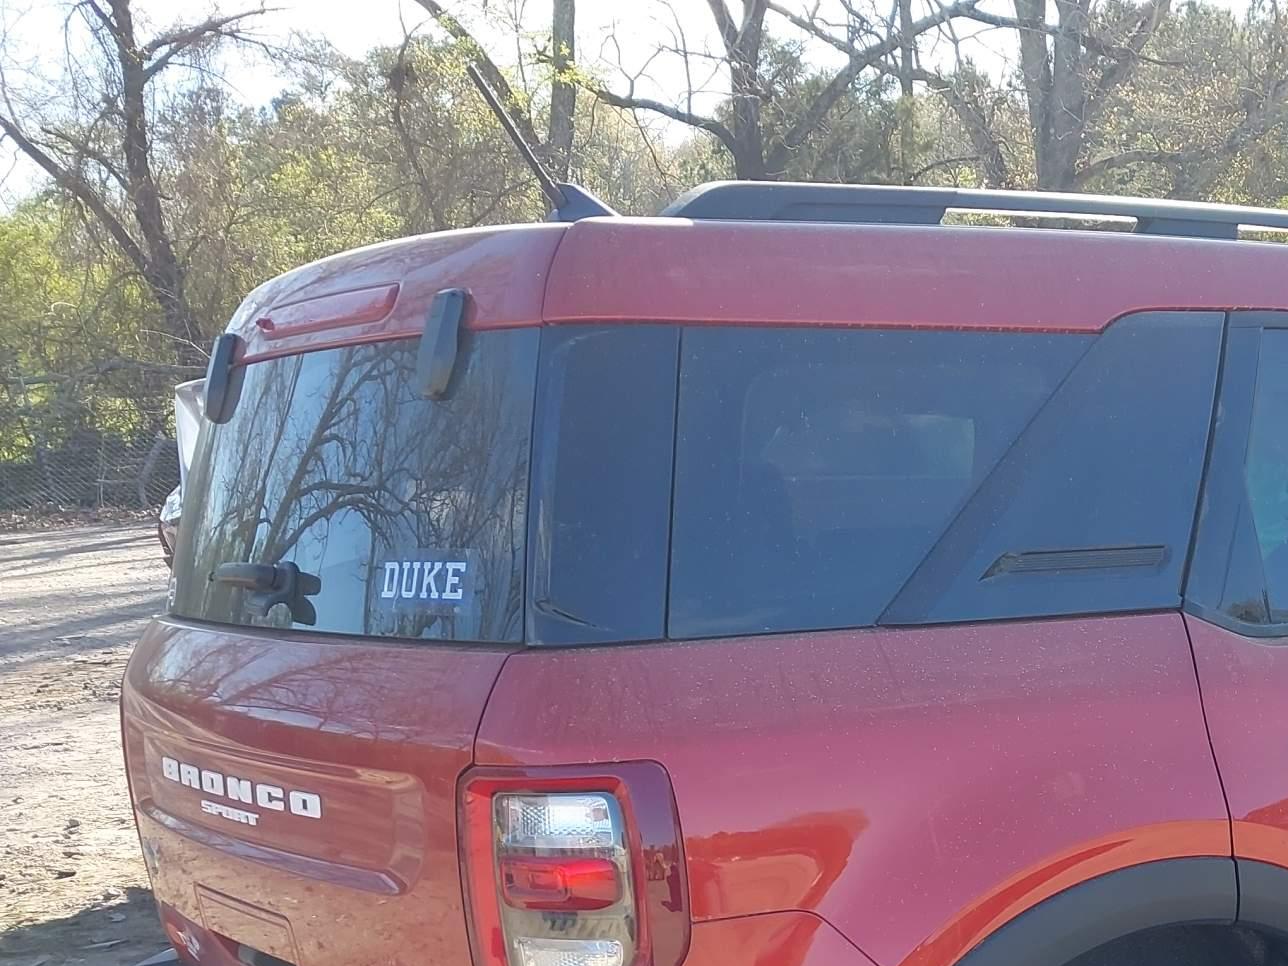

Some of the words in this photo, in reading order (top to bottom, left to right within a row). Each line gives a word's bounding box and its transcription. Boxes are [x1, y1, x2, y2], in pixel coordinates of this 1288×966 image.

[381, 561, 467, 600] DUKE
[162, 756, 322, 819] BRONCO
[201, 799, 259, 826] SPORT
